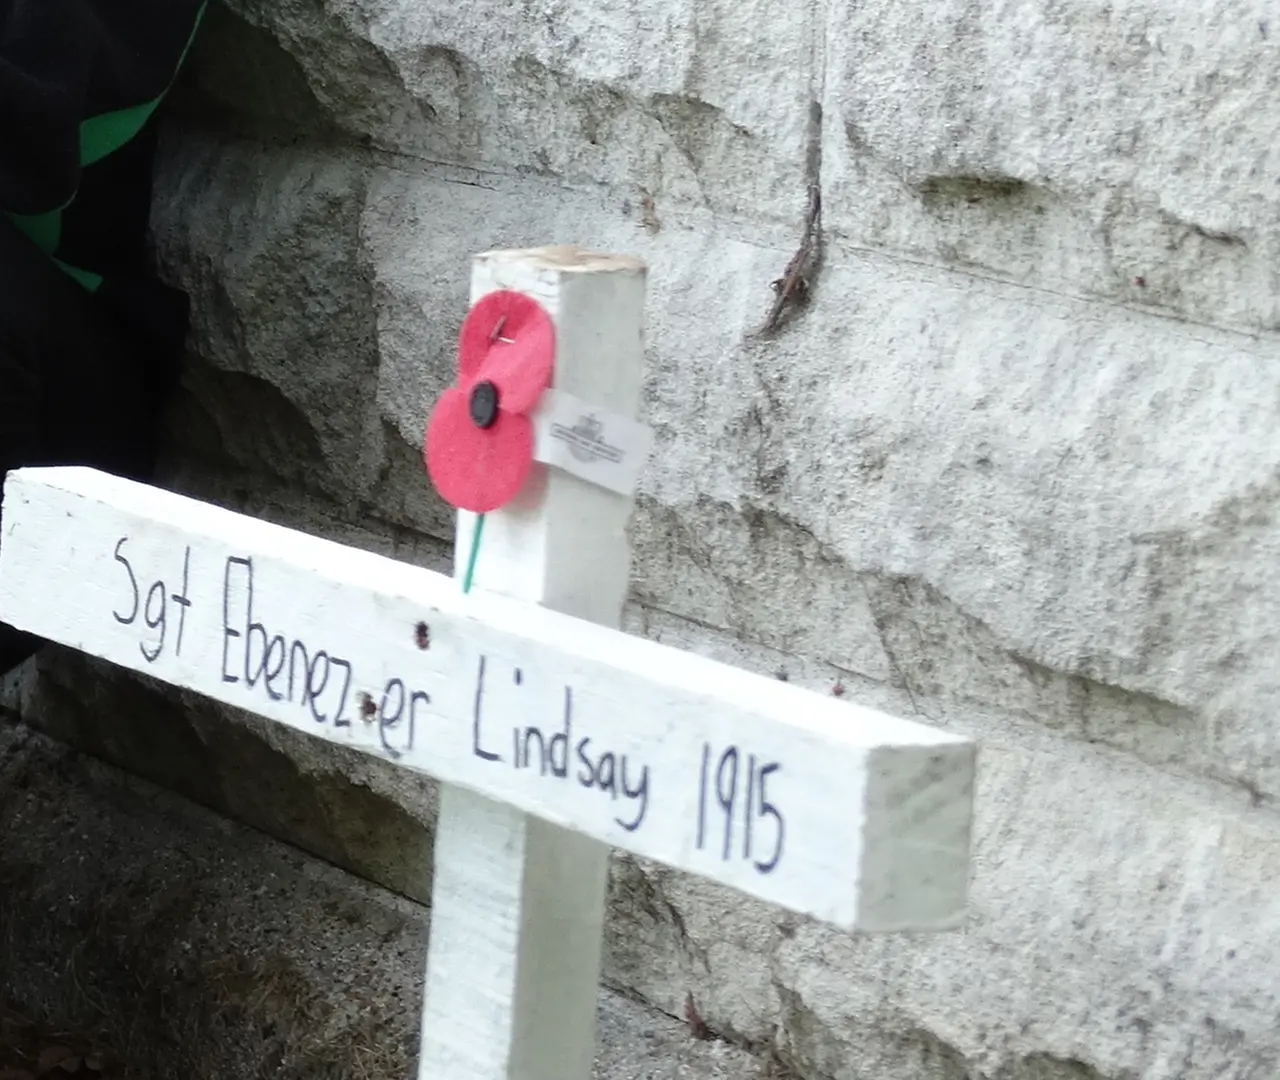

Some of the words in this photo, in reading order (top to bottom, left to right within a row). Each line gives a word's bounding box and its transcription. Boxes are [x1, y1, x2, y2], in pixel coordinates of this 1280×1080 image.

[112, 535, 193, 664] Sgt
[220, 555, 432, 761] Ebenezer
[471, 653, 651, 832] Lindsay
[694, 740, 786, 874] 1915
